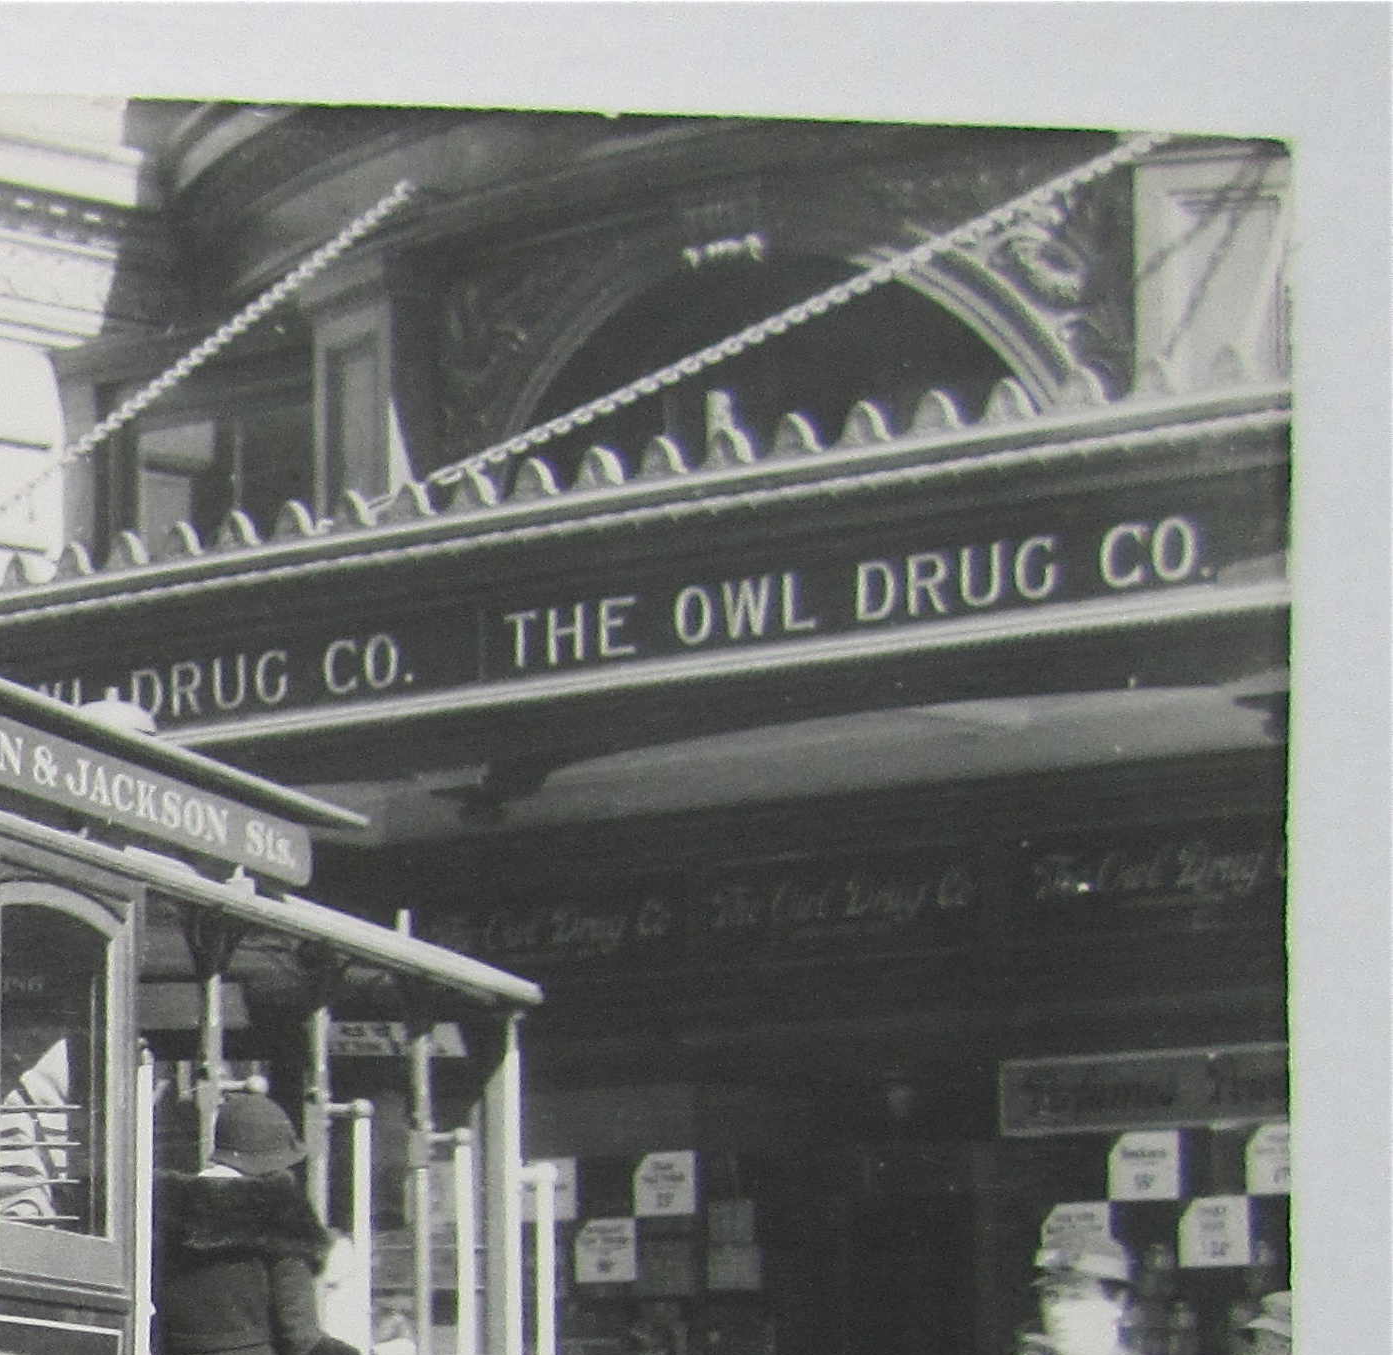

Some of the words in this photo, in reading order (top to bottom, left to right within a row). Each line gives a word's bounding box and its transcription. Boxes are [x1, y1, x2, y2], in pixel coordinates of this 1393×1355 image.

[504, 595, 637, 668] THE
[674, 571, 820, 646] OWL
[855, 535, 1058, 623] DRUG
[1100, 515, 1214, 591] CO.
[131, 650, 289, 718] DRUG
[323, 633, 414, 695] CO.
[32, 745, 60, 789] &
[64, 760, 229, 844] JACKSON
